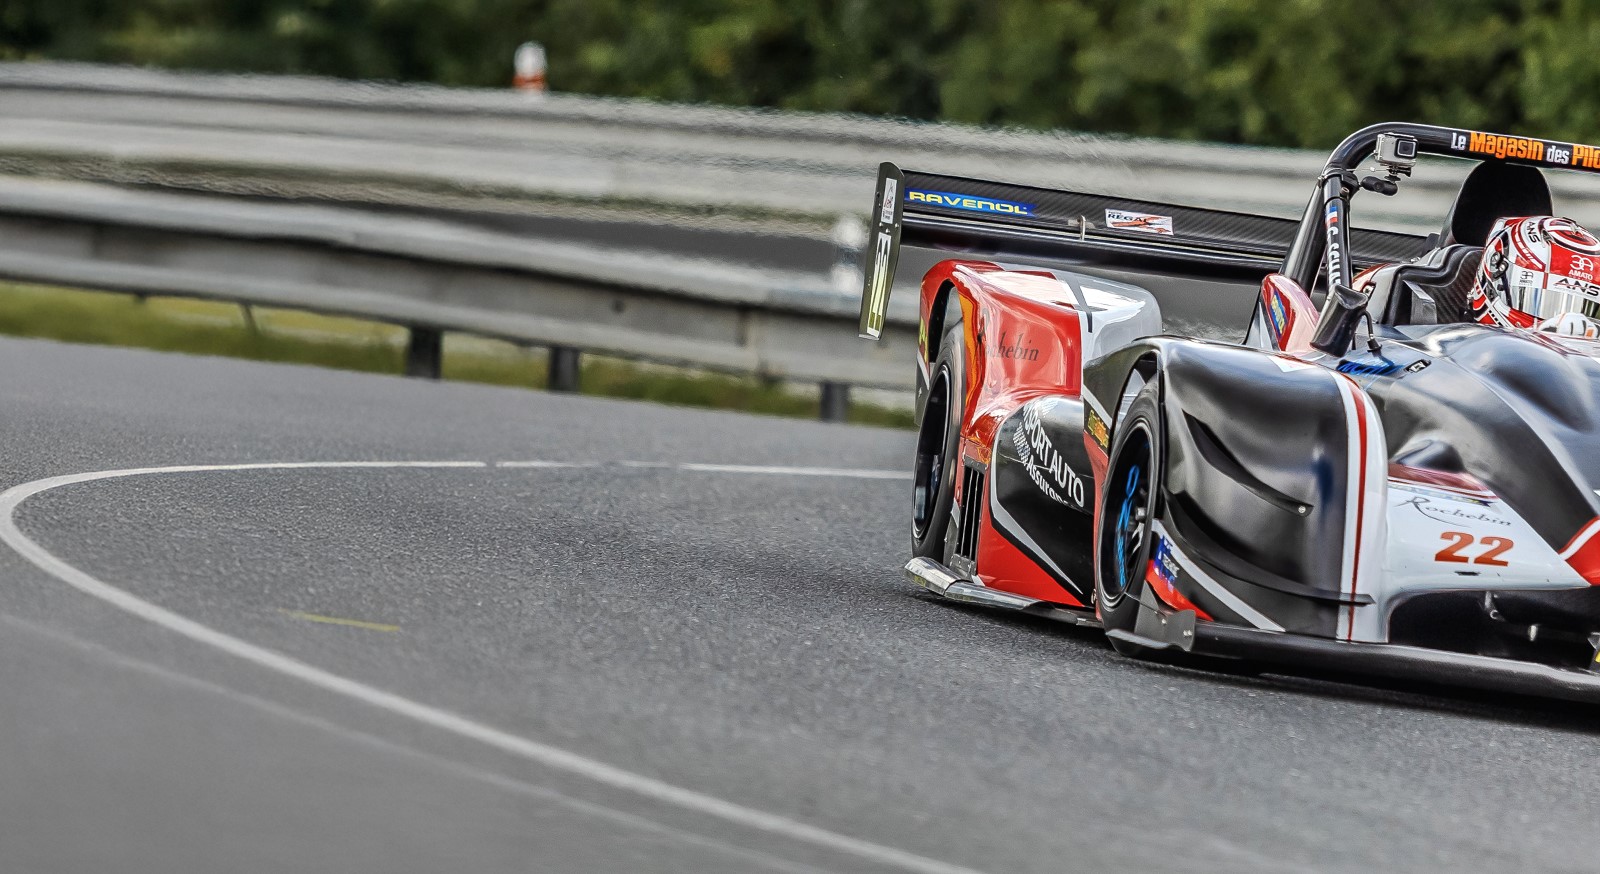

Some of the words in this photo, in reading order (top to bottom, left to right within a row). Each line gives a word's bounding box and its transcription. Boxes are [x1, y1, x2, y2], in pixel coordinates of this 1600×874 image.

[1451, 132, 1466, 151] Le
[1469, 131, 1544, 159] Magasin
[1546, 145, 1570, 165] des
[909, 191, 1028, 215] RAVENOL
[1527, 221, 1540, 243] ANS
[1553, 277, 1600, 297] ANS
[1568, 269, 1593, 281] AMATO
[1049, 450, 1084, 508] AUTO
[1393, 496, 1511, 528] Rochebin
[1434, 531, 1514, 567] 22
